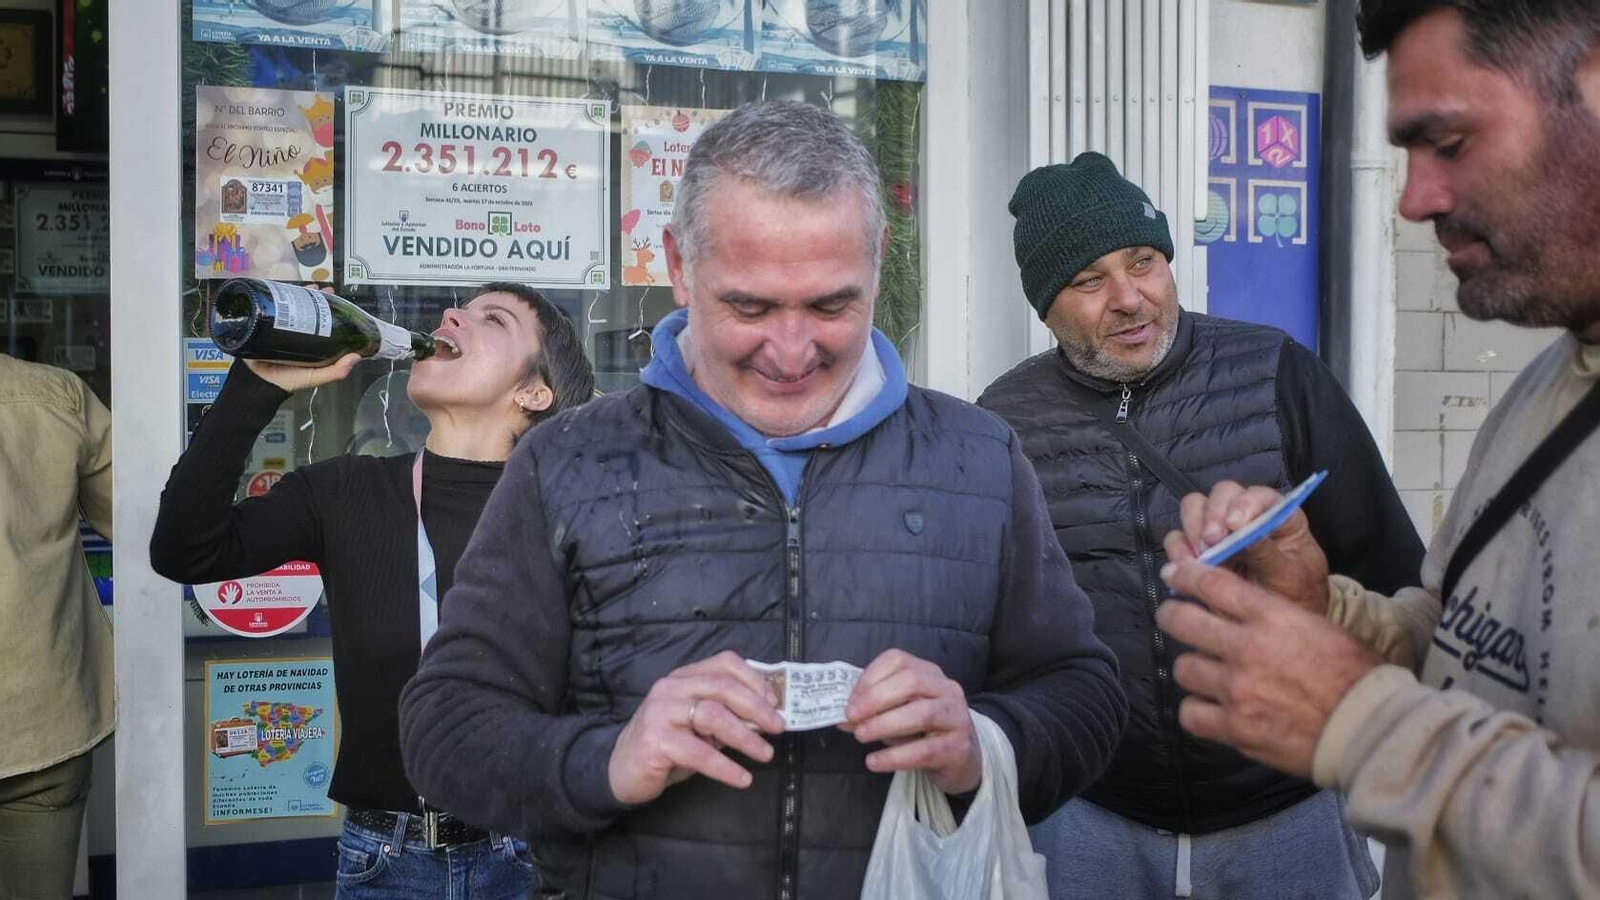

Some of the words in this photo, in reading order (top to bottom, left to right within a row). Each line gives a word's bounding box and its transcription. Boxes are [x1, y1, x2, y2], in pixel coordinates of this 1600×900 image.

[258, 33, 271, 42] YA
[282, 35, 295, 44] LA
[297, 36, 331, 46] VENTA
[644, 53, 656, 62] YA
[665, 55, 676, 63] LA
[678, 56, 708, 65] VENTA
[848, 67, 876, 76] VENTA
[229, 106, 246, 115] DEL
[248, 107, 285, 117] BARRIO
[443, 102, 514, 120] PREMIO
[420, 123, 537, 142] MILLONARIO
[664, 141, 693, 152] Loter
[207, 136, 237, 164] El
[239, 144, 302, 169] Niño
[381, 141, 558, 179] 2.351.212
[652, 159, 666, 175] El
[252, 182, 283, 193] 87341
[452, 183, 459, 192] 6
[461, 183, 508, 194] ACIERTOS
[72, 190, 108, 200] PREMI
[58, 202, 108, 212] MILLONA
[36, 213, 108, 231] 2.351.2
[455, 219, 486, 231] Bono
[514, 220, 541, 233] Loto
[383, 235, 498, 258] VENDIDO
[507, 235, 571, 261] AQUÍ
[38, 265, 104, 277] VENDIDO
[194, 349, 224, 360] VISA
[199, 376, 221, 384] VISA
[280, 563, 311, 571] ABILIDAD
[217, 671, 234, 679] HAY
[237, 668, 274, 679] LOTERÍA
[276, 669, 287, 678] DE
[291, 668, 328, 677] NAVIDAD
[224, 684, 236, 693] DE
[238, 684, 267, 692] OTRAS
[269, 682, 322, 691] PROVINCIAS
